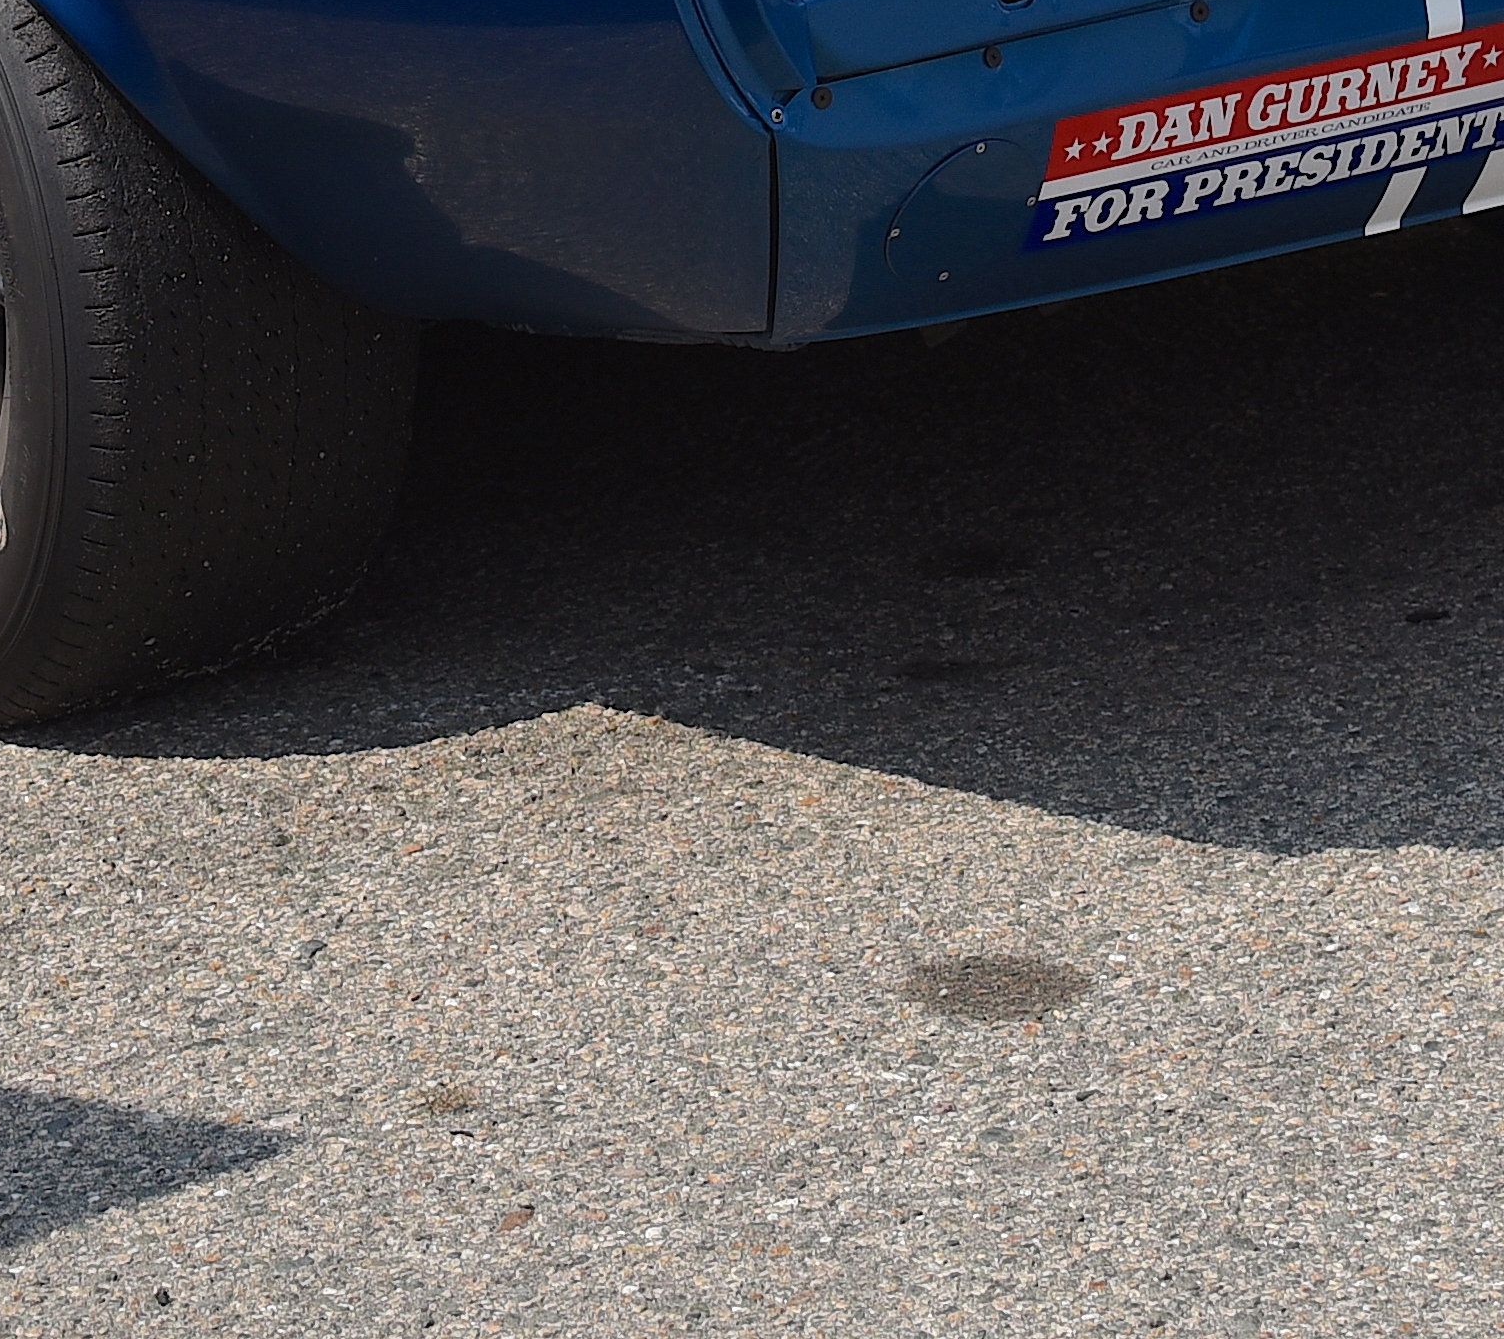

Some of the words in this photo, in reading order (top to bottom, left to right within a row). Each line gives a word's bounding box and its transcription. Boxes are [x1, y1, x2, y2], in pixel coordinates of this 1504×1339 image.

[1109, 91, 1243, 162] DAN
[1245, 40, 1483, 132] GURNEY
[1150, 154, 1192, 172] CAR
[1195, 144, 1241, 163] AND
[1242, 125, 1320, 152] DRIVER
[1320, 101, 1432, 135] CANDIDATE
[1042, 180, 1173, 243] FOR
